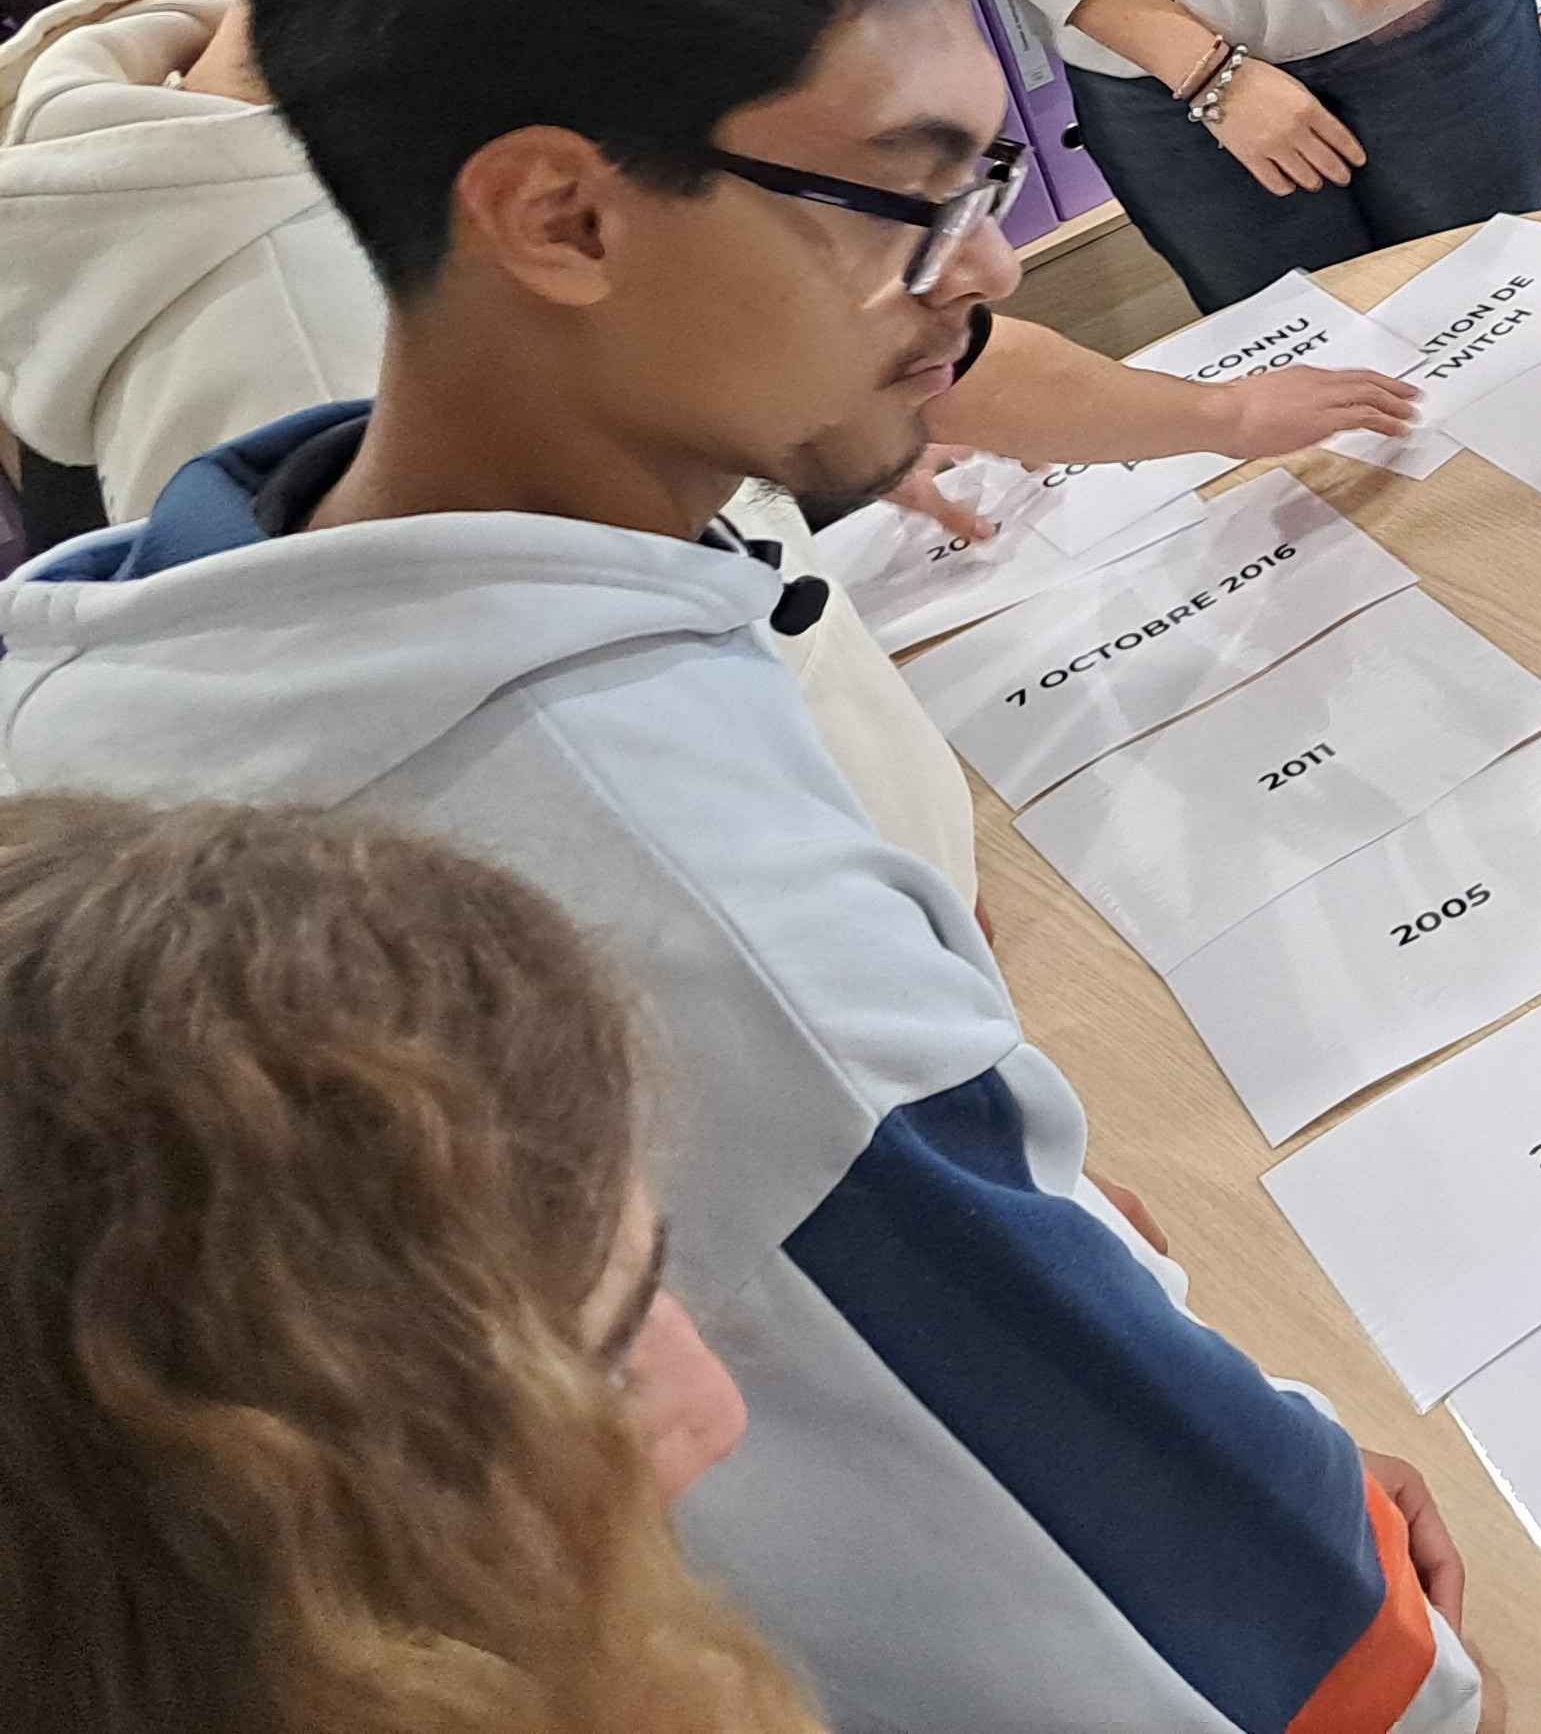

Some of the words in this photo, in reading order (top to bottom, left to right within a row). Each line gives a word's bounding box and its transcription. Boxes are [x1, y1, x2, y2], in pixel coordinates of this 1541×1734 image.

[1490, 275, 1534, 301] DE
[1245, 330, 1330, 377] PORT
[1424, 309, 1533, 378] TWITCH
[1005, 688, 1029, 709] 7
[1039, 591, 1217, 691] OCTOBRE
[1218, 542, 1297, 593] 2016
[1257, 742, 1337, 791] 2011
[1389, 883, 1492, 946] 2005
